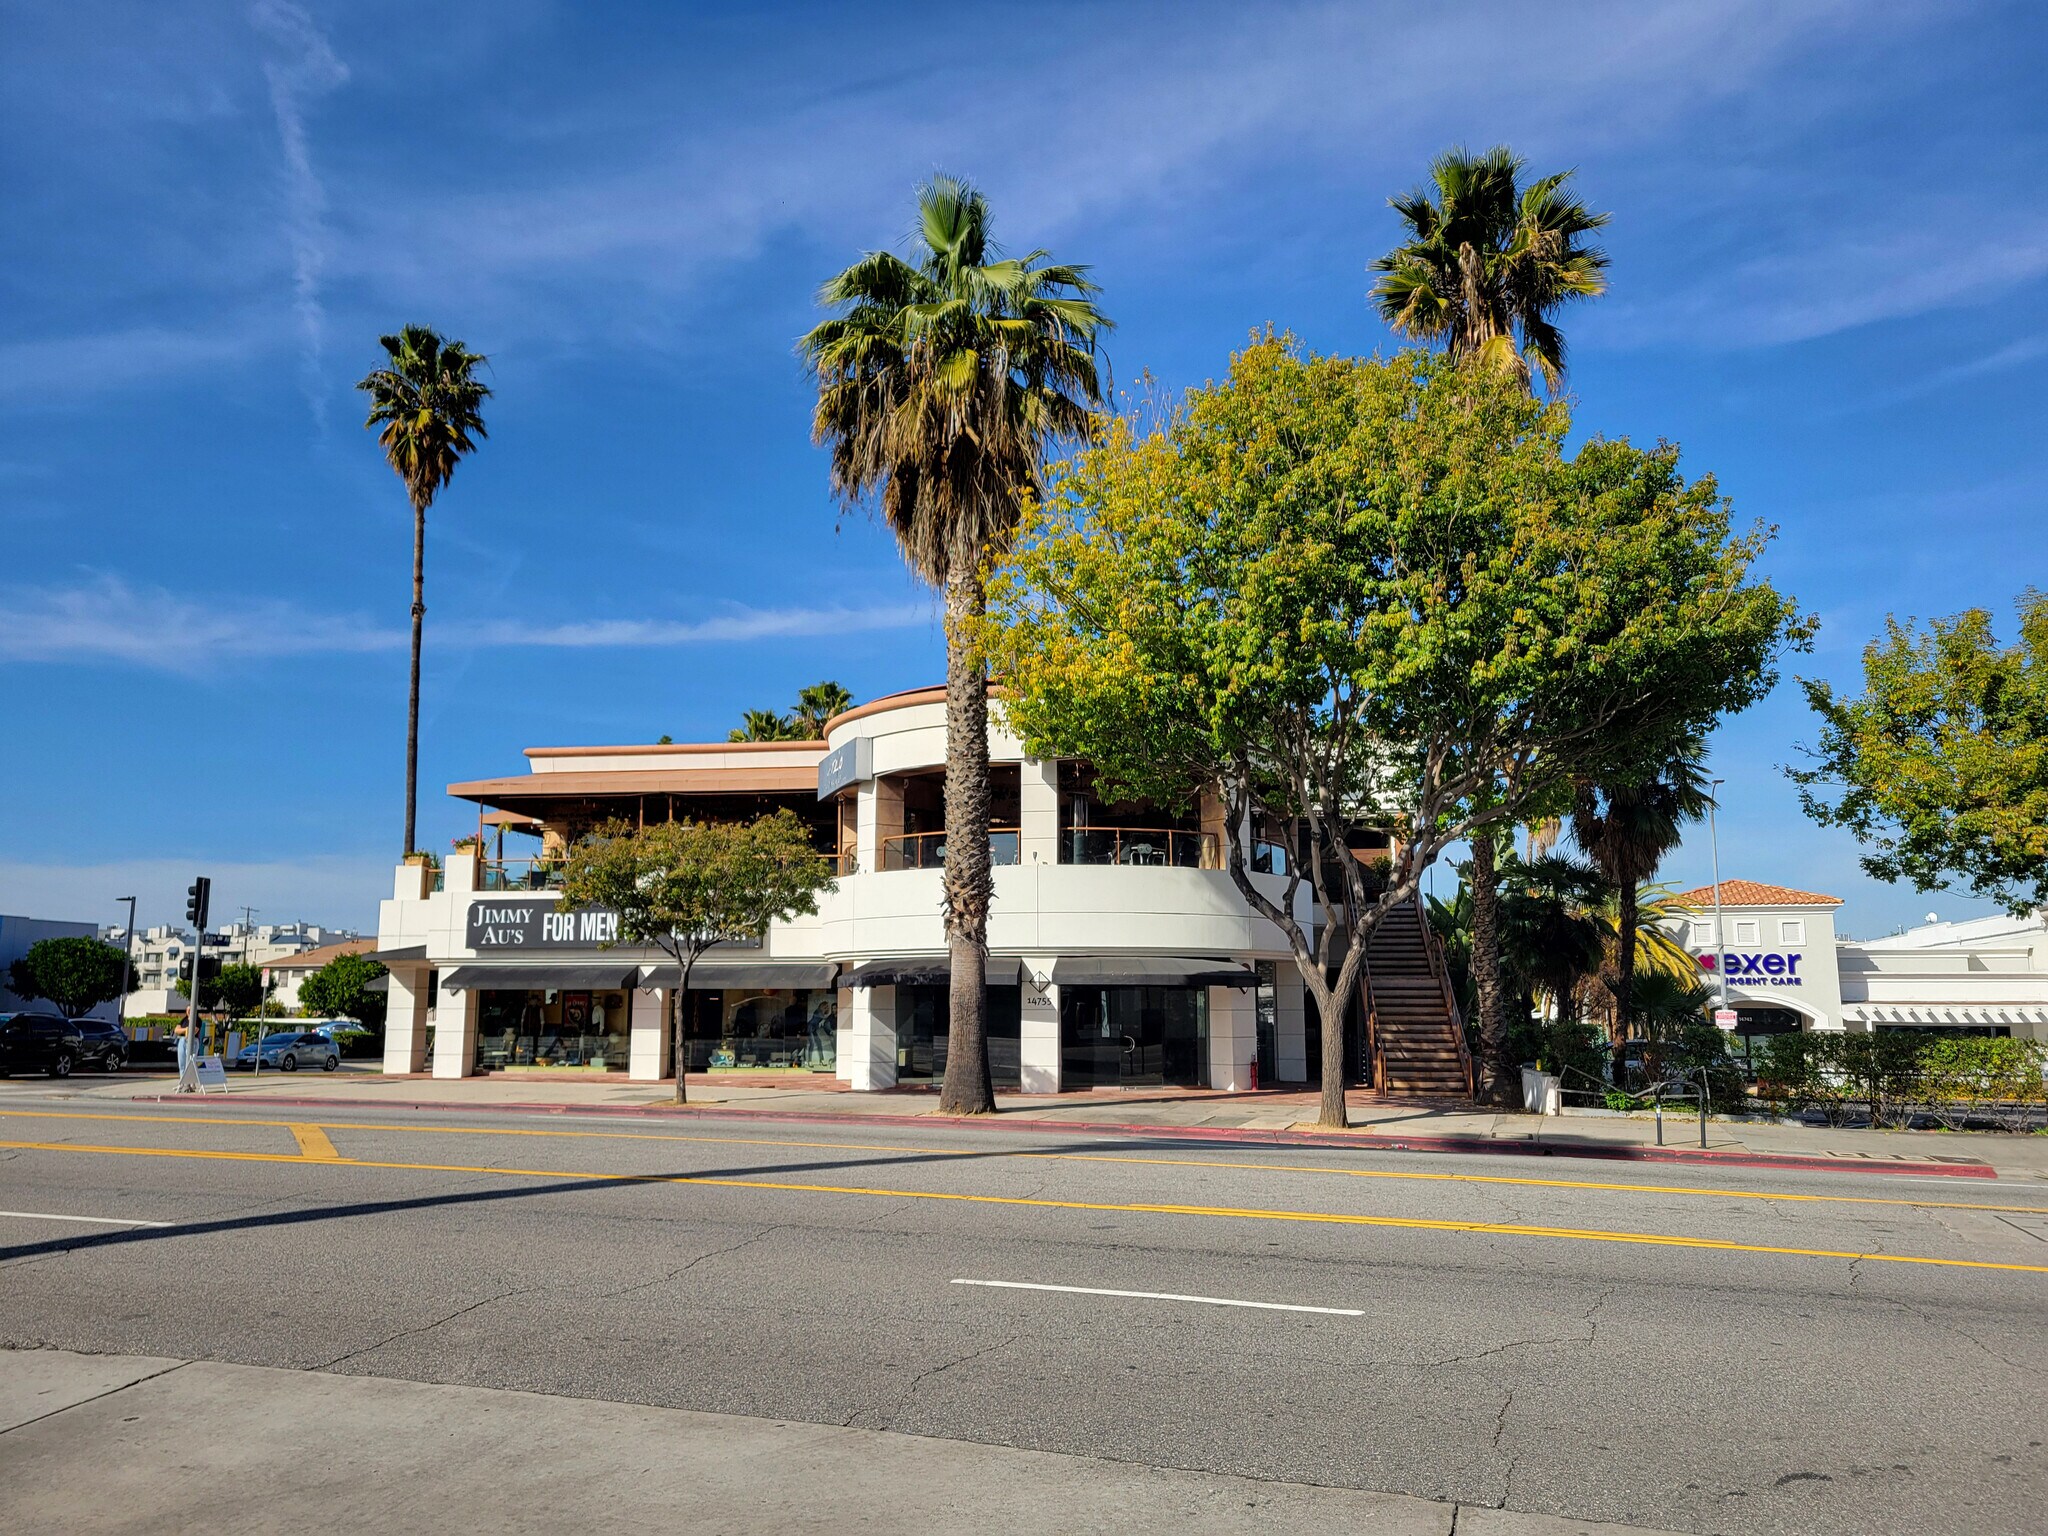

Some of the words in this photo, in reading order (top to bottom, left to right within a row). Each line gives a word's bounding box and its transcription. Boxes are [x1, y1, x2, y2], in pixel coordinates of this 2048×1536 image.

[473, 905, 534, 927] JIMMY
[480, 926, 524, 945] AU'S
[542, 912, 575, 942] FOR
[580, 912, 618, 942] MEN
[1723, 953, 1803, 976] exer
[1771, 977, 1802, 987] CARE
[1027, 997, 1052, 1006] 14755
